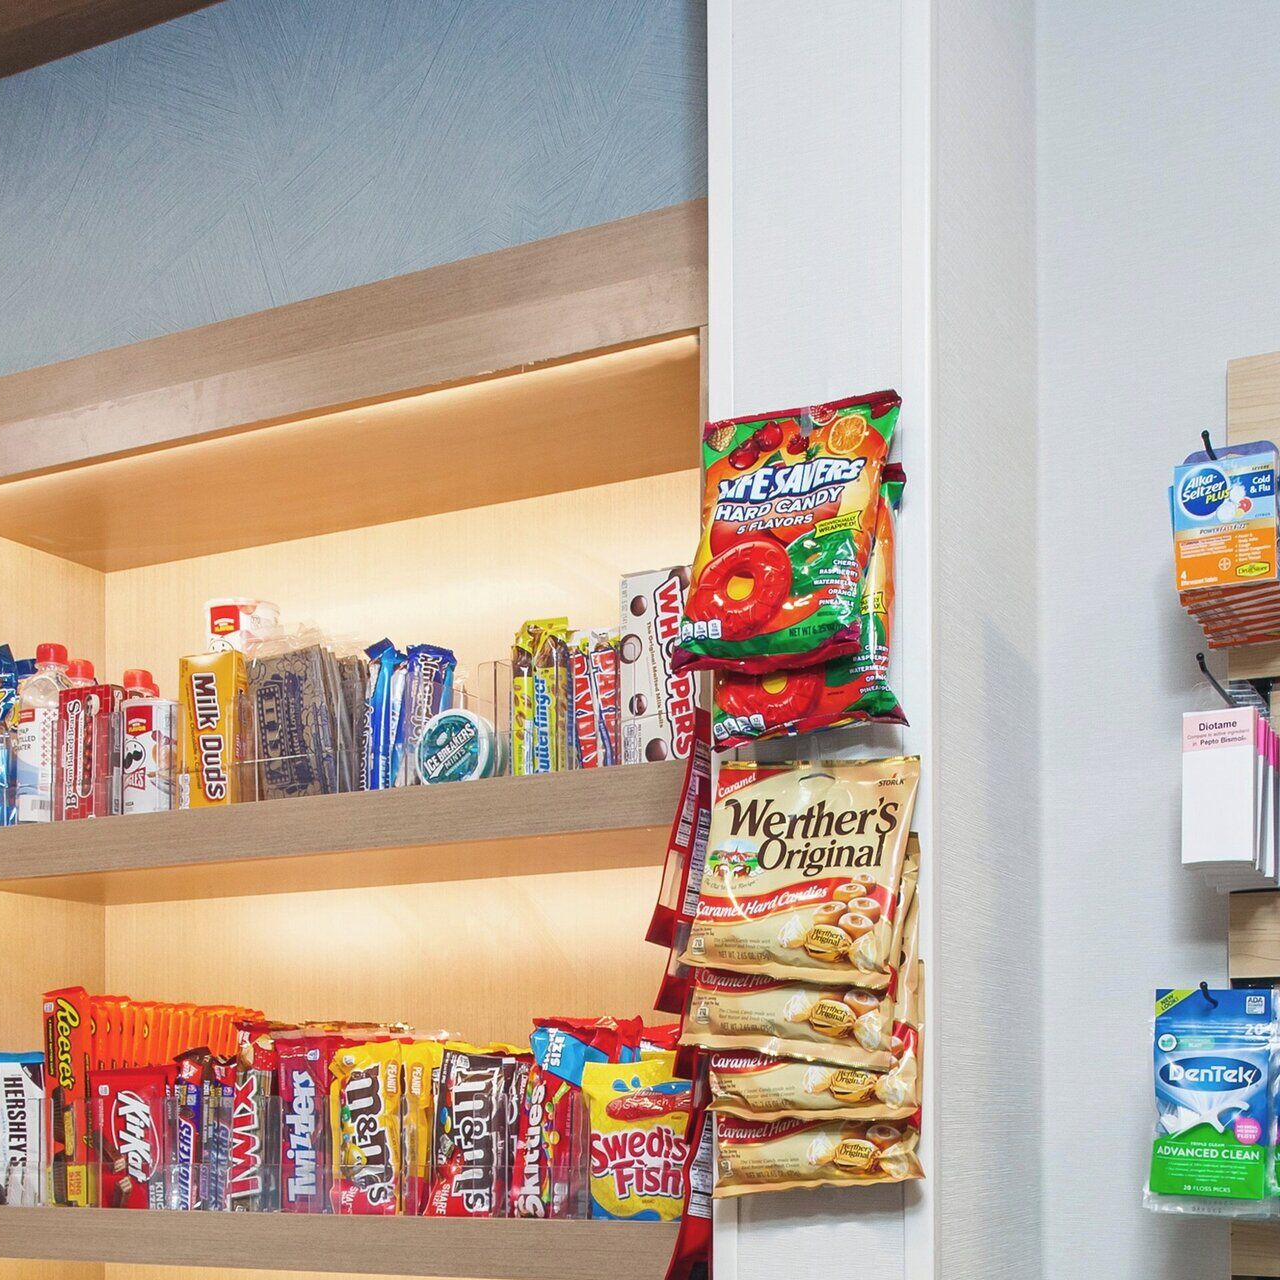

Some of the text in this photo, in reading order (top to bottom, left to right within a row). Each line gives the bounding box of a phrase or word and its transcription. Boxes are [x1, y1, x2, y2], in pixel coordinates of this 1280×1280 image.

[1182, 480, 1226, 503] Seltzer
[1185, 473, 1217, 489] Alka-
[1252, 475, 1270, 485] Cold
[715, 486, 844, 522] HARD CANDY
[1206, 488, 1230, 504] PLUS
[193, 674, 227, 799] Milk Duds
[1198, 720, 1237, 731] Diotame
[423, 723, 477, 774] ICE BREAKERS
[718, 773, 756, 798] Caramel
[724, 796, 899, 840] Werther's
[756, 832, 885, 876] Original
[696, 886, 829, 918] Caramel Hard Candies
[700, 969, 749, 989] Caramel
[57, 998, 80, 1090] Reese's
[387, 1064, 398, 1094] PEANUT
[411, 1065, 423, 1096] PEANUT
[1169, 1065, 1256, 1083] DenTek
[3, 1076, 27, 1168] HERSHEY'S
[1157, 1146, 1259, 1160] ADVANCED CLEAN
[613, 1161, 684, 1199] Fish
